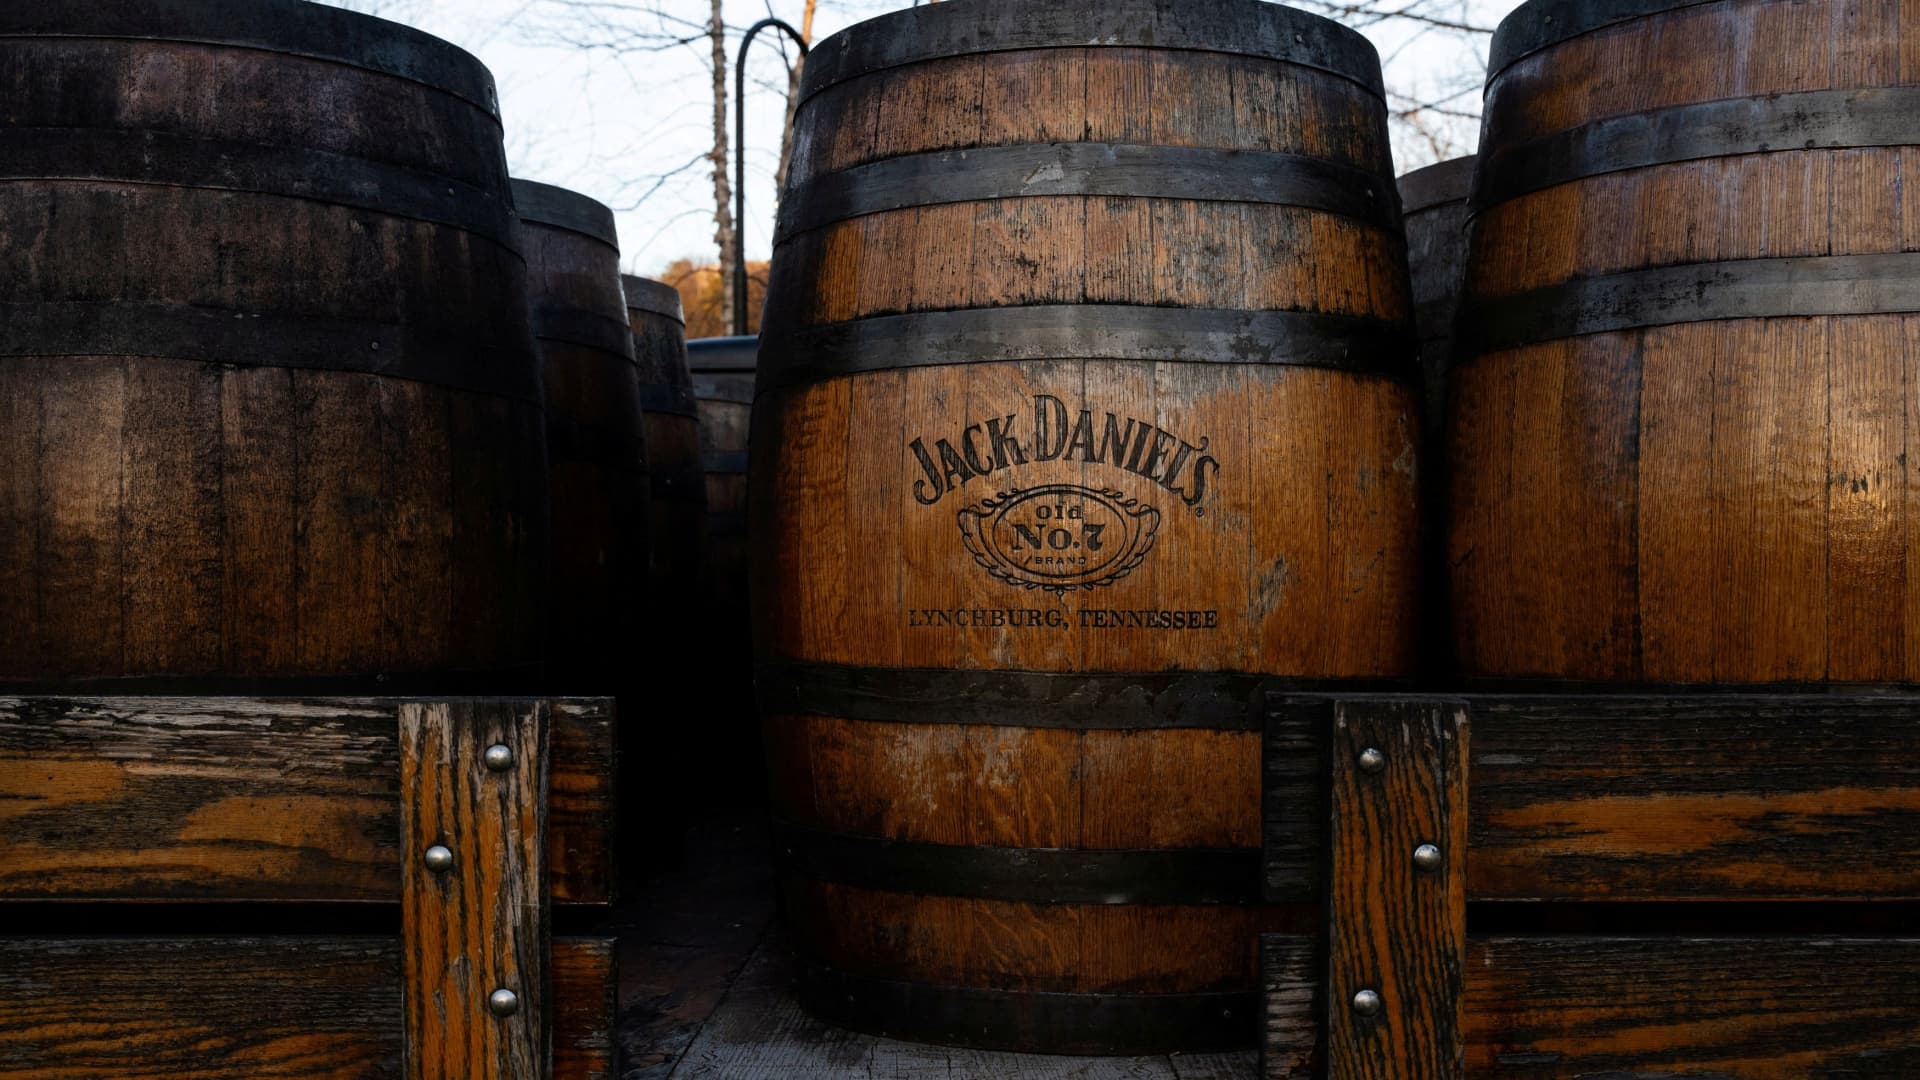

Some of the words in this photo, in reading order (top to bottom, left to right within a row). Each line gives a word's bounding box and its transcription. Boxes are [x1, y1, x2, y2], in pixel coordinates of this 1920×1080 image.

[909, 413, 1028, 505] JACK
[1033, 394, 1220, 506] DANIEL'S
[1035, 556, 1086, 565] BRAND
[909, 609, 1069, 630] LYNCHBURG,
[1077, 609, 1218, 629] TENNESSEE
